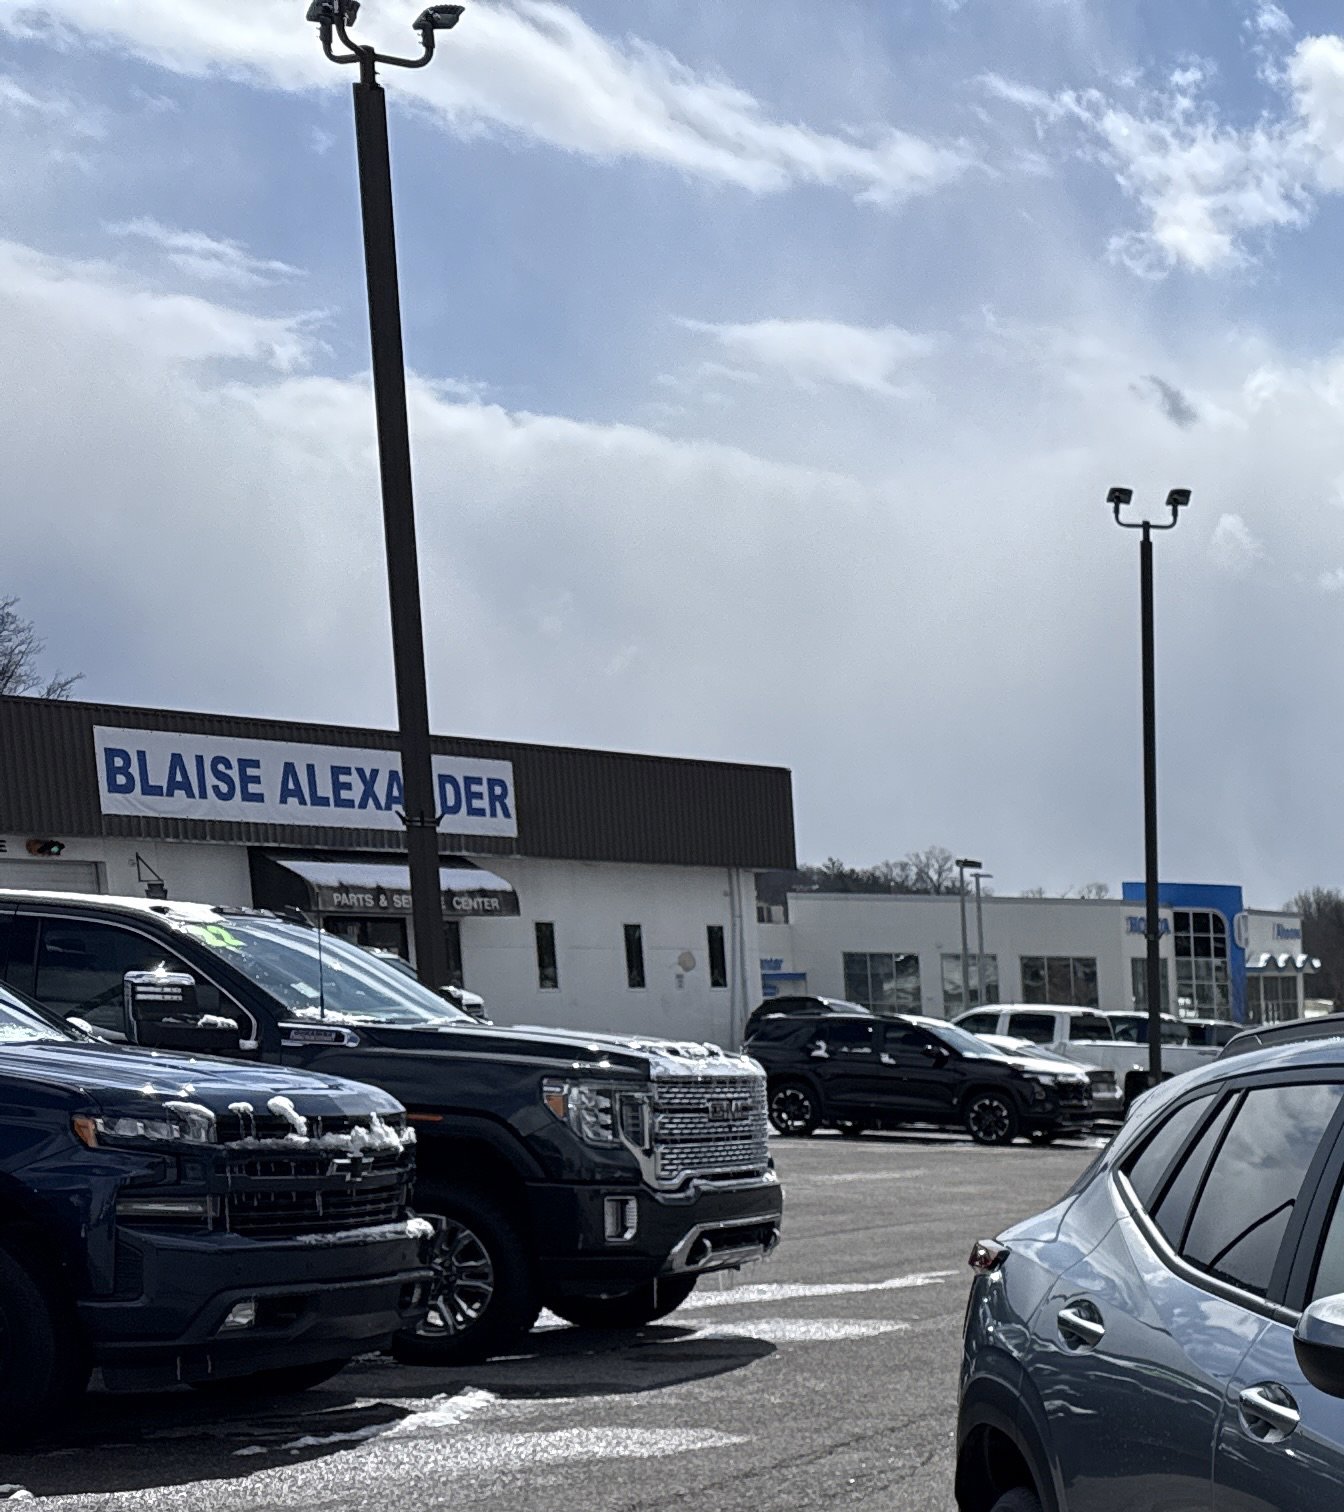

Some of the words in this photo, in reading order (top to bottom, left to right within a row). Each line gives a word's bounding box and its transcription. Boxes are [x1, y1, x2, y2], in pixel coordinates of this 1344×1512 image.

[103, 746, 265, 804] BLAISE
[278, 760, 512, 819] ALEXADER
[332, 892, 375, 908] PARTS
[378, 895, 388, 908] &
[452, 897, 500, 911] CENTER
